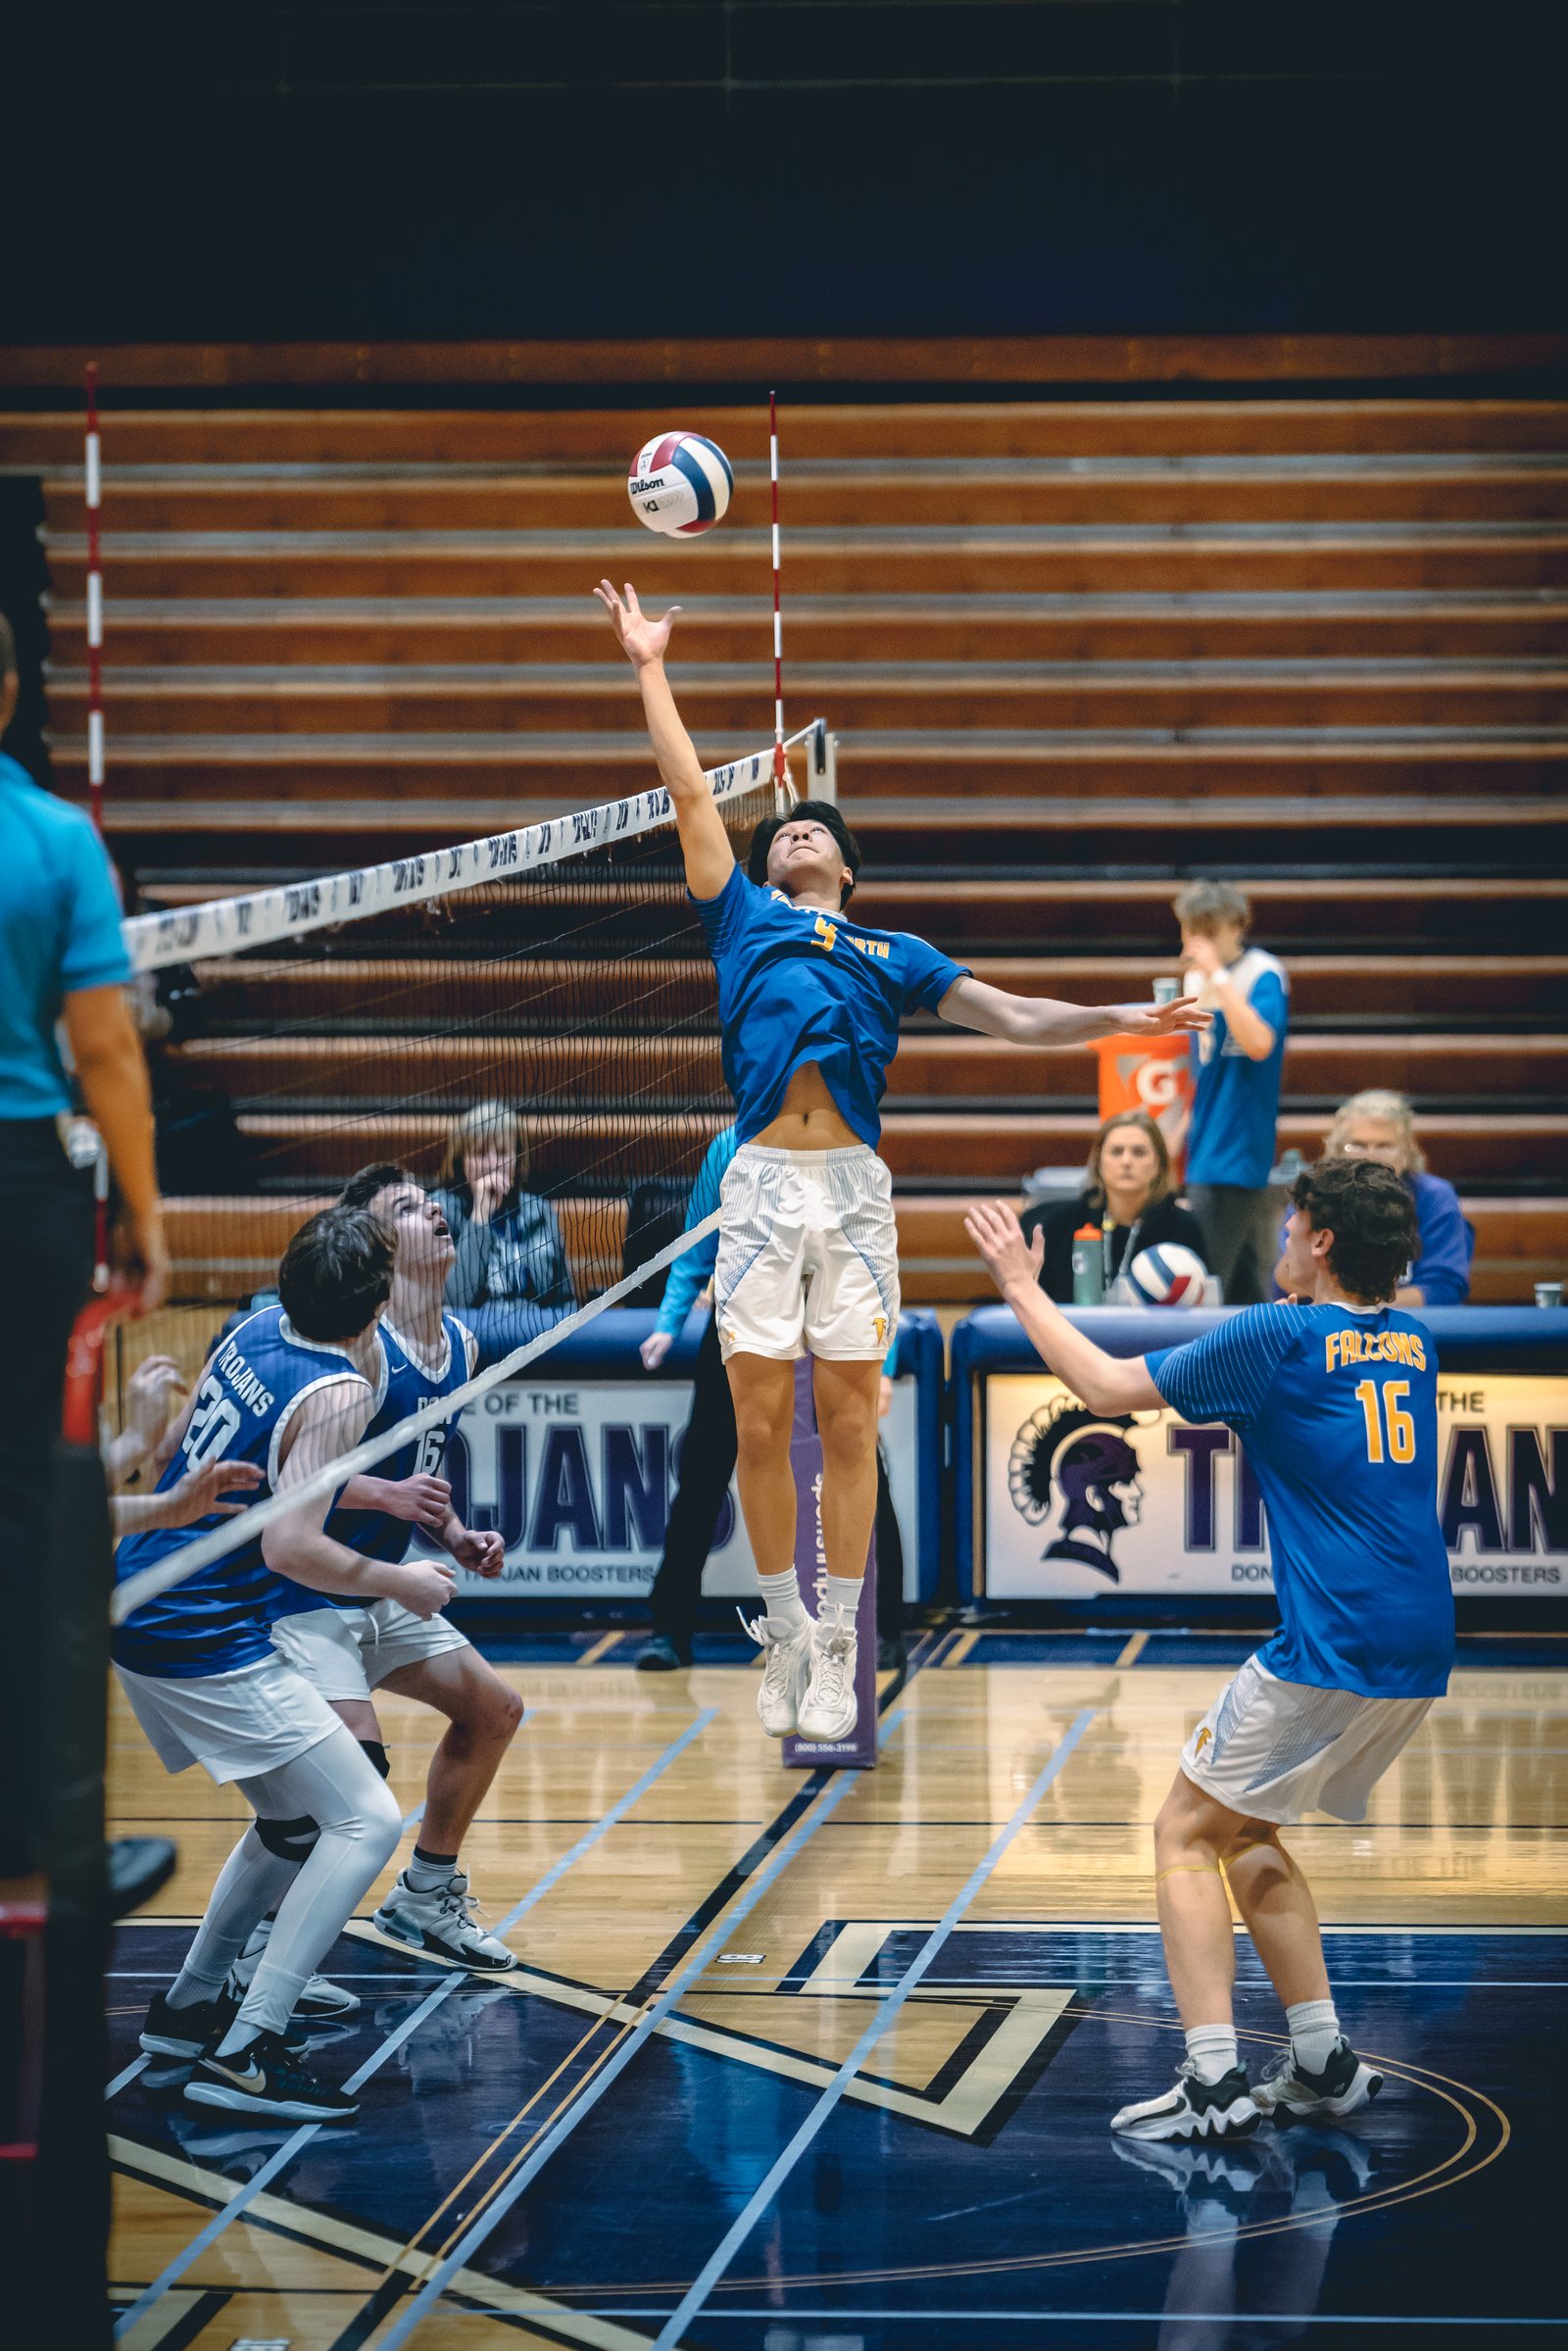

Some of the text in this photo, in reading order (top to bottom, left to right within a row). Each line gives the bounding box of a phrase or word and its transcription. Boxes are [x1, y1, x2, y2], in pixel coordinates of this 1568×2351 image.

[630, 477, 665, 495] Wilson
[1137, 1059, 1176, 1104] G
[1325, 1329, 1427, 1373] FALCONS
[484, 1393, 519, 1415] OF
[527, 1393, 579, 1415] THE
[1438, 1391, 1485, 1413] THE
[181, 1374, 241, 1472] 20
[1354, 1379, 1416, 1464] 16
[413, 1430, 446, 1475] 16
[1231, 1564, 1561, 1584] DON BOOSTERS
[794, 1742, 816, 1753] (800)
